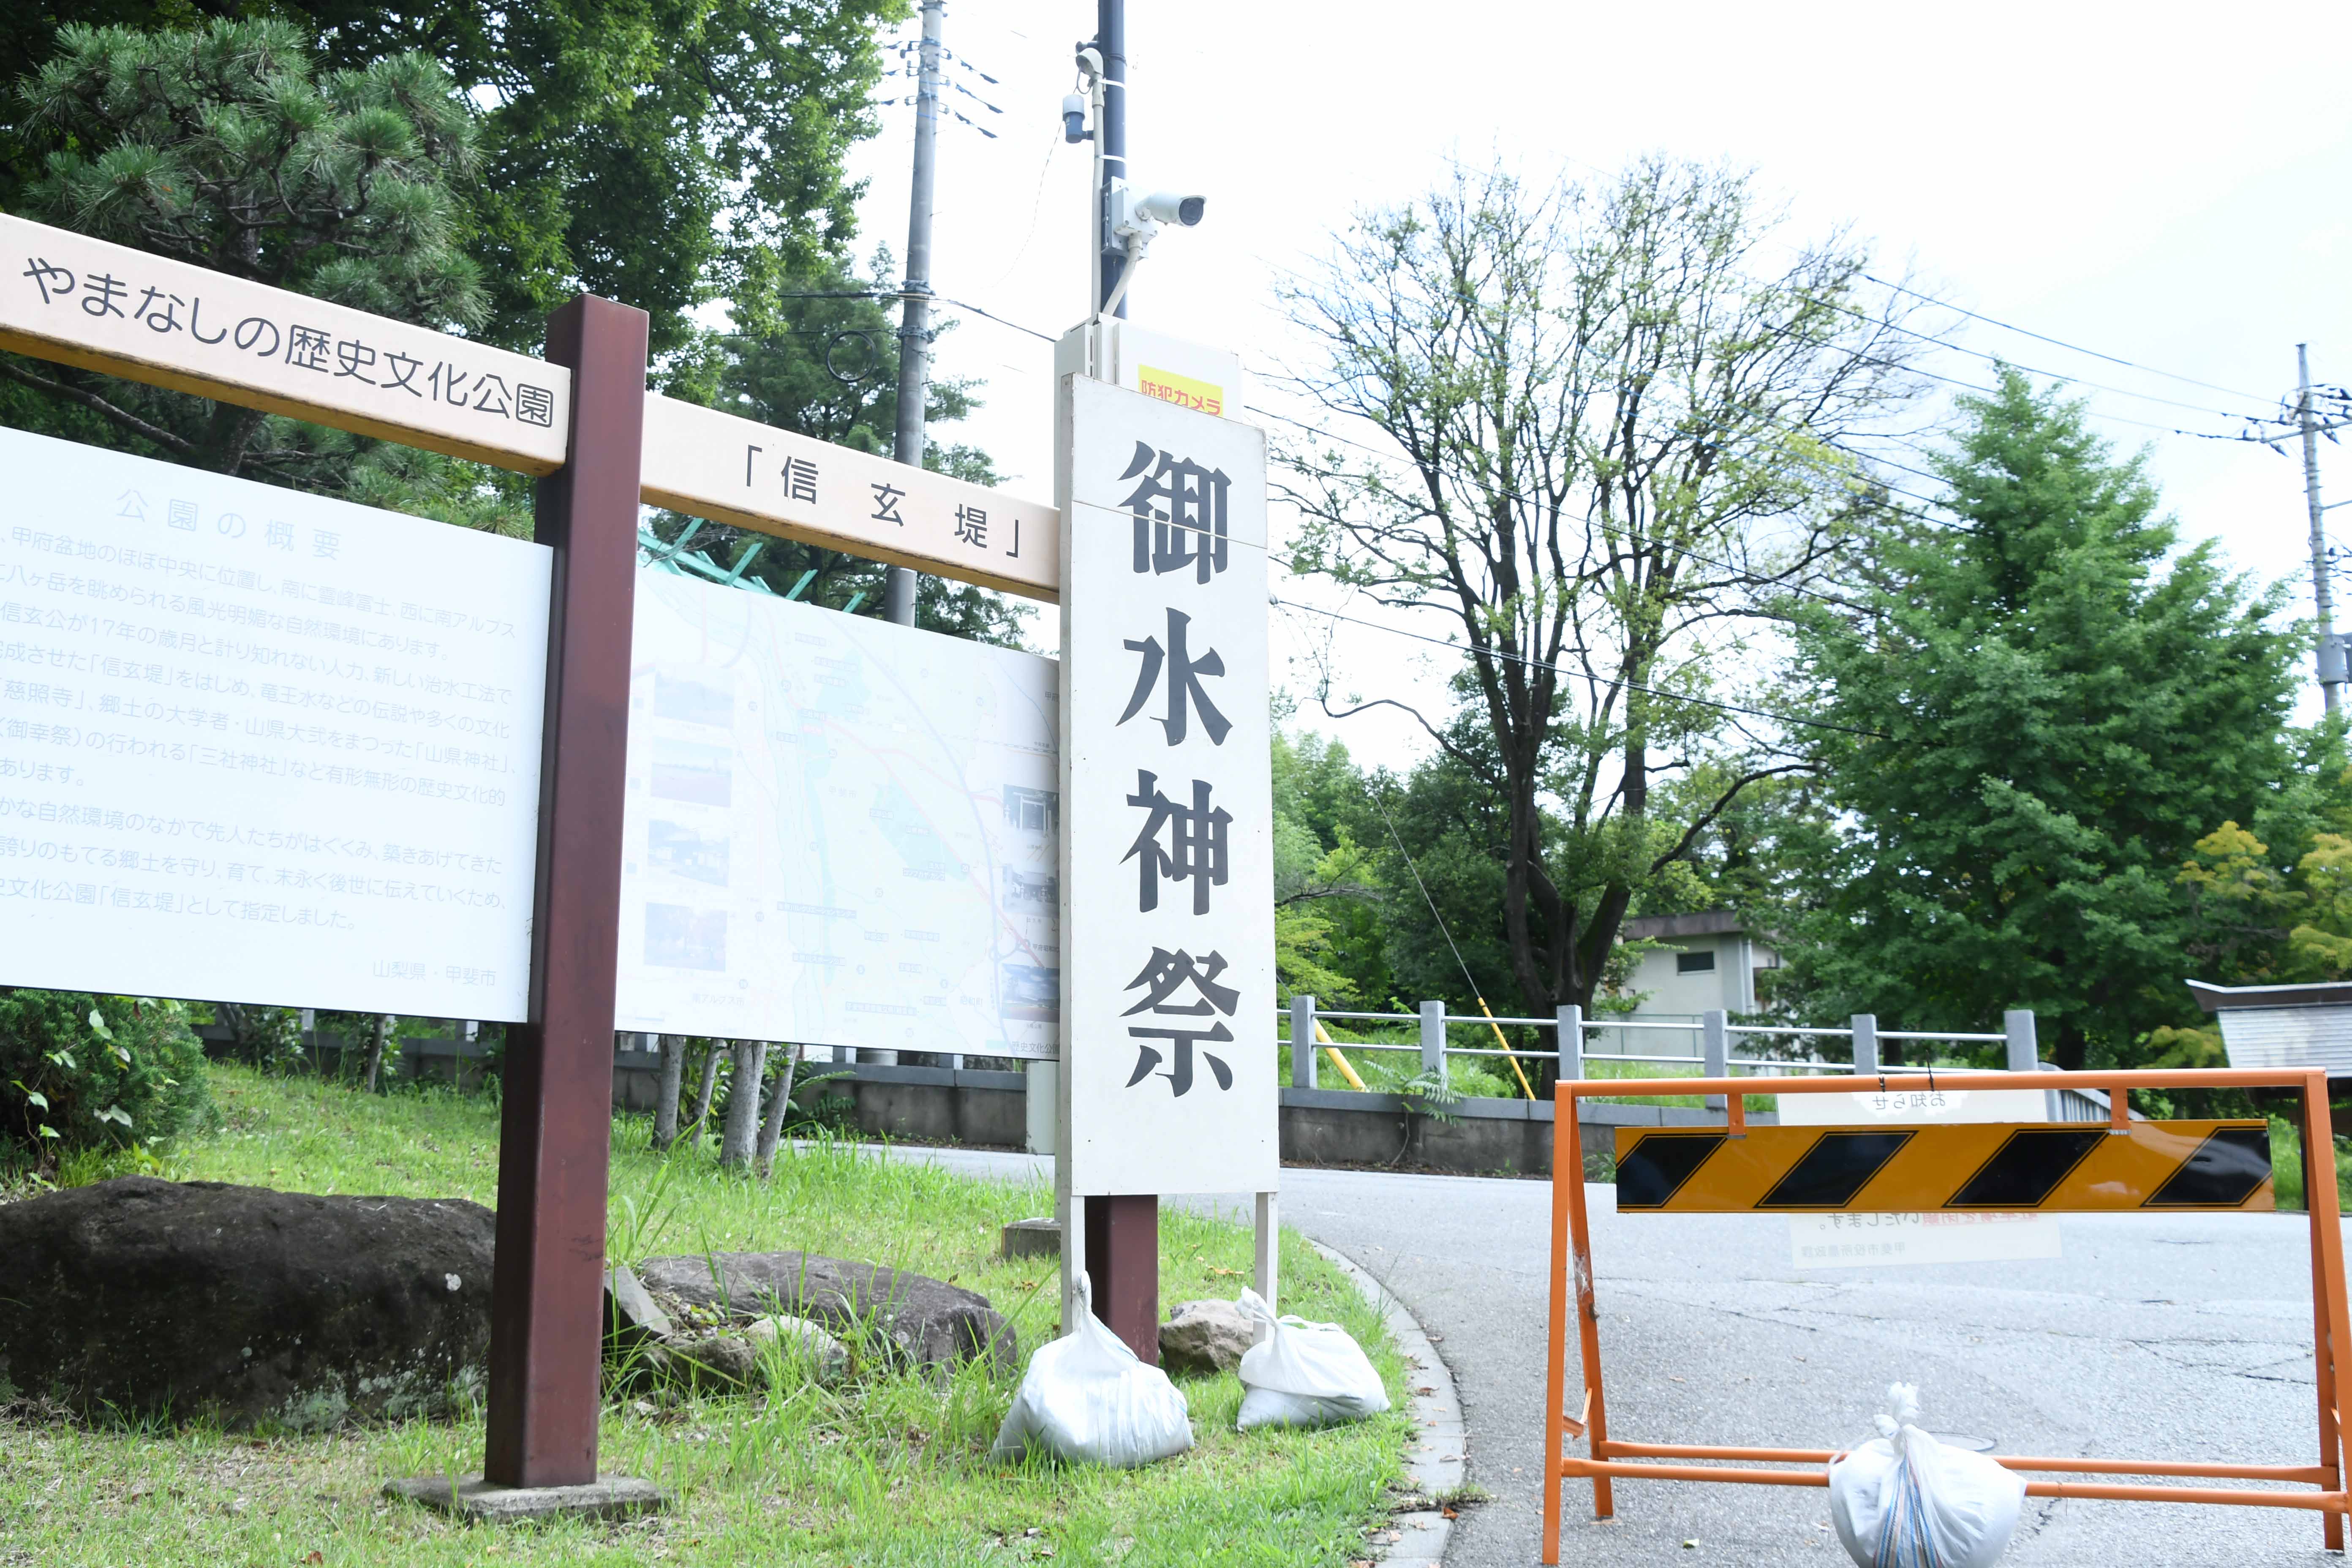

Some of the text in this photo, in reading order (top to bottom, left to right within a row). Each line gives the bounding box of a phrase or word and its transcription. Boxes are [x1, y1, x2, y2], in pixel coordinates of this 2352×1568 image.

[22, 256, 554, 429] やまなしの歴史文化公園
[1141, 379, 1220, 416] 防犯カメラ
[115, 488, 341, 561] 公園の概要
[745, 444, 1020, 559] 「信玄堤」
[0, 640, 510, 740] 成させた「信玄堤」をはじめ、竜王水などの伝説や多くの文化
[0, 678, 516, 774] 慈照寺」、郷土の大学者・山県大弐をまつった「山県神社」、
[1116, 440, 1241, 1098] 御水神祭
[0, 877, 355, 931] 文化公園「信玄堤」として指定しました。
